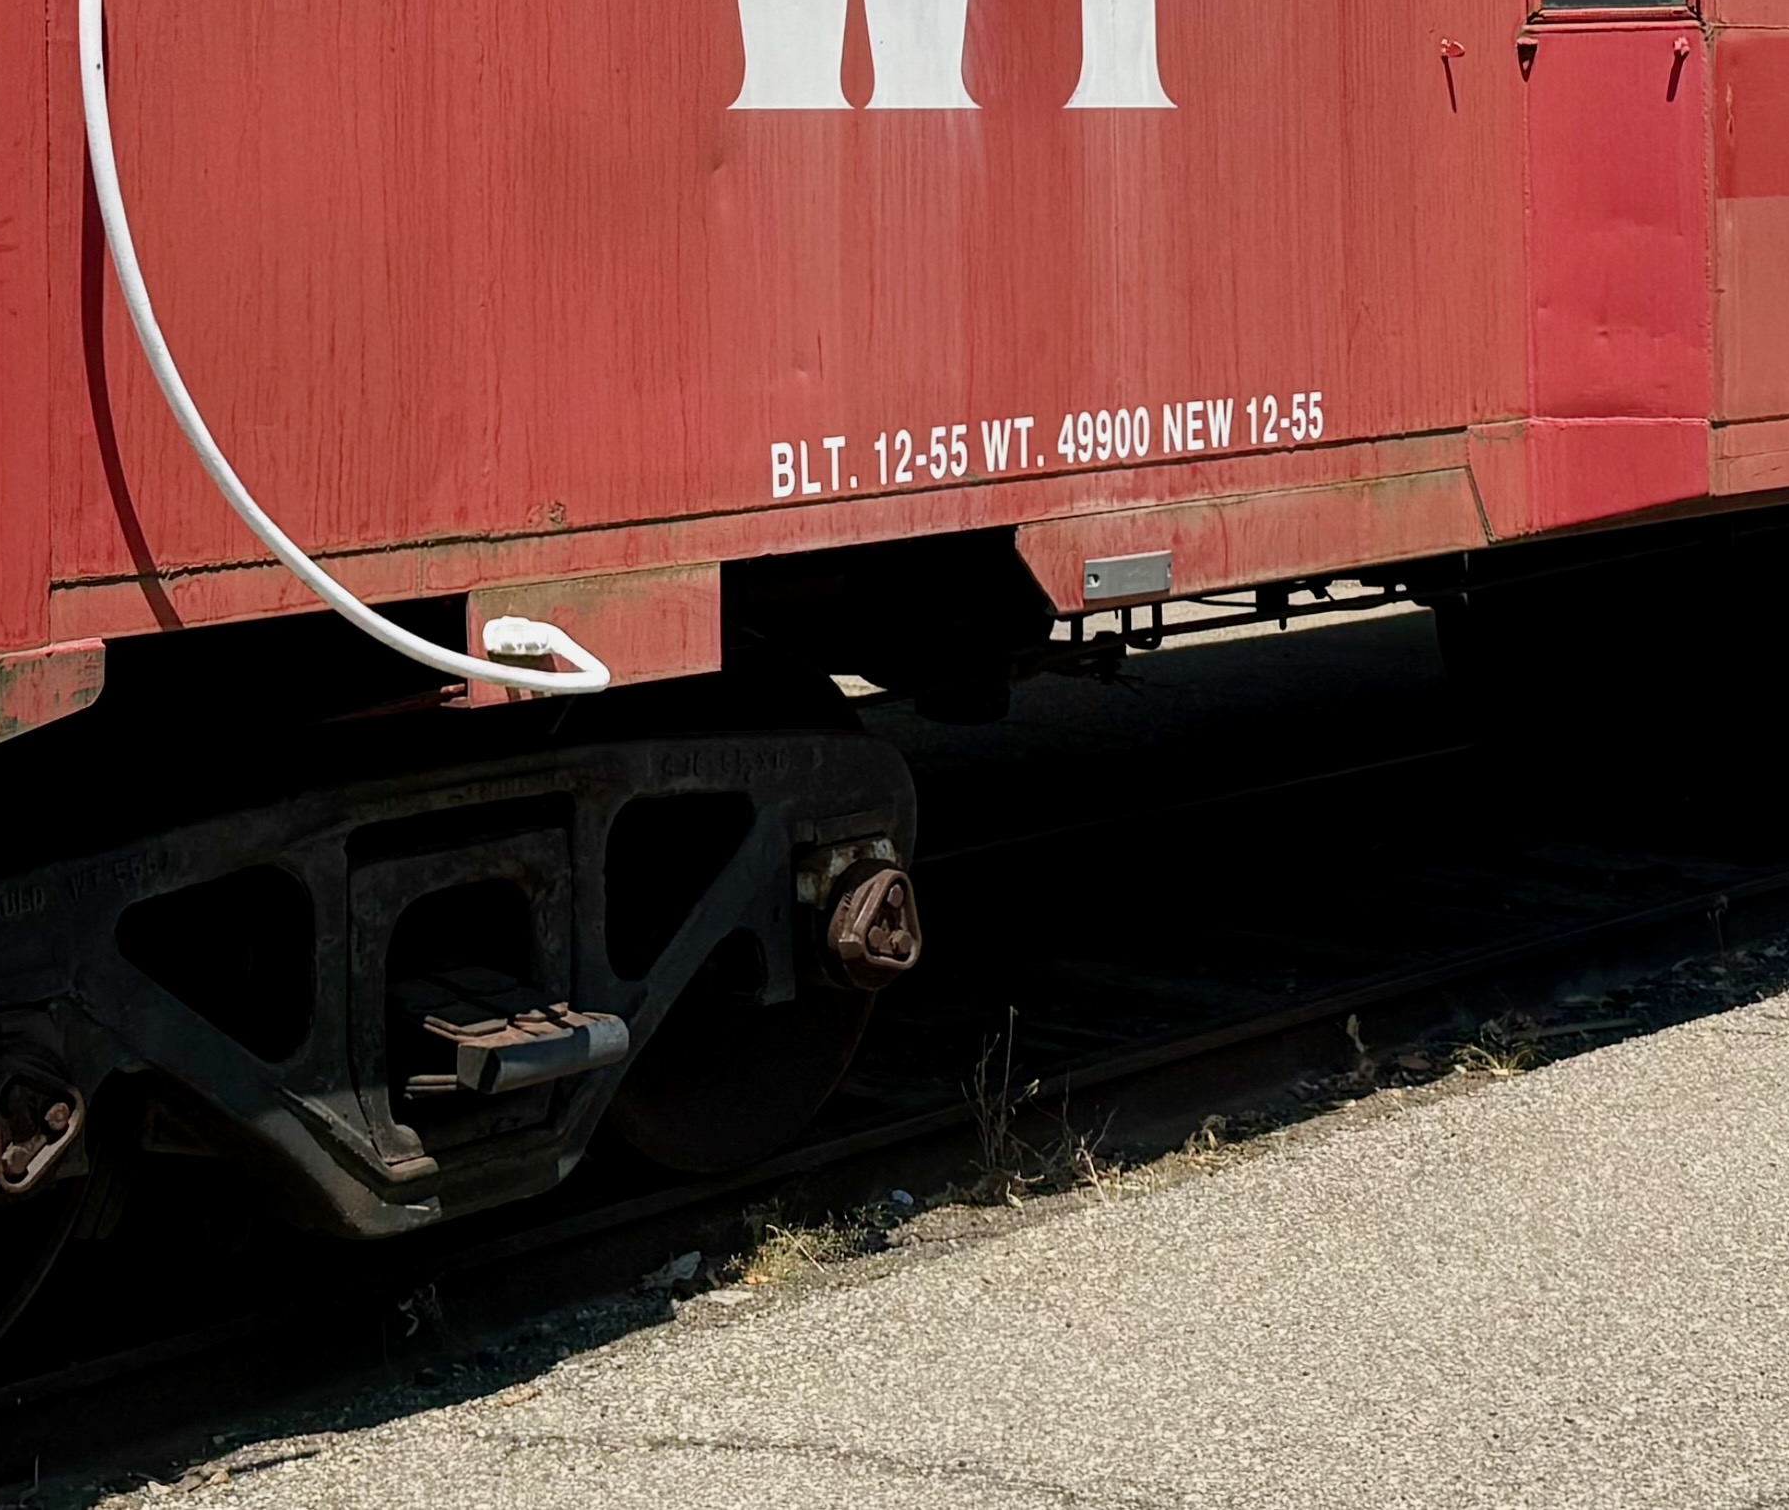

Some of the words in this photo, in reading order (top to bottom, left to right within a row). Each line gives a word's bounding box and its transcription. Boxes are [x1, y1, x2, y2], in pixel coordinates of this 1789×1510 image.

[771, 436, 858, 498] BLT.
[874, 424, 968, 485] 12-55
[981, 416, 1045, 472] WT.
[1058, 406, 1150, 464] 49900
[1163, 398, 1234, 453] NEW
[1246, 391, 1324, 443] 12-55
